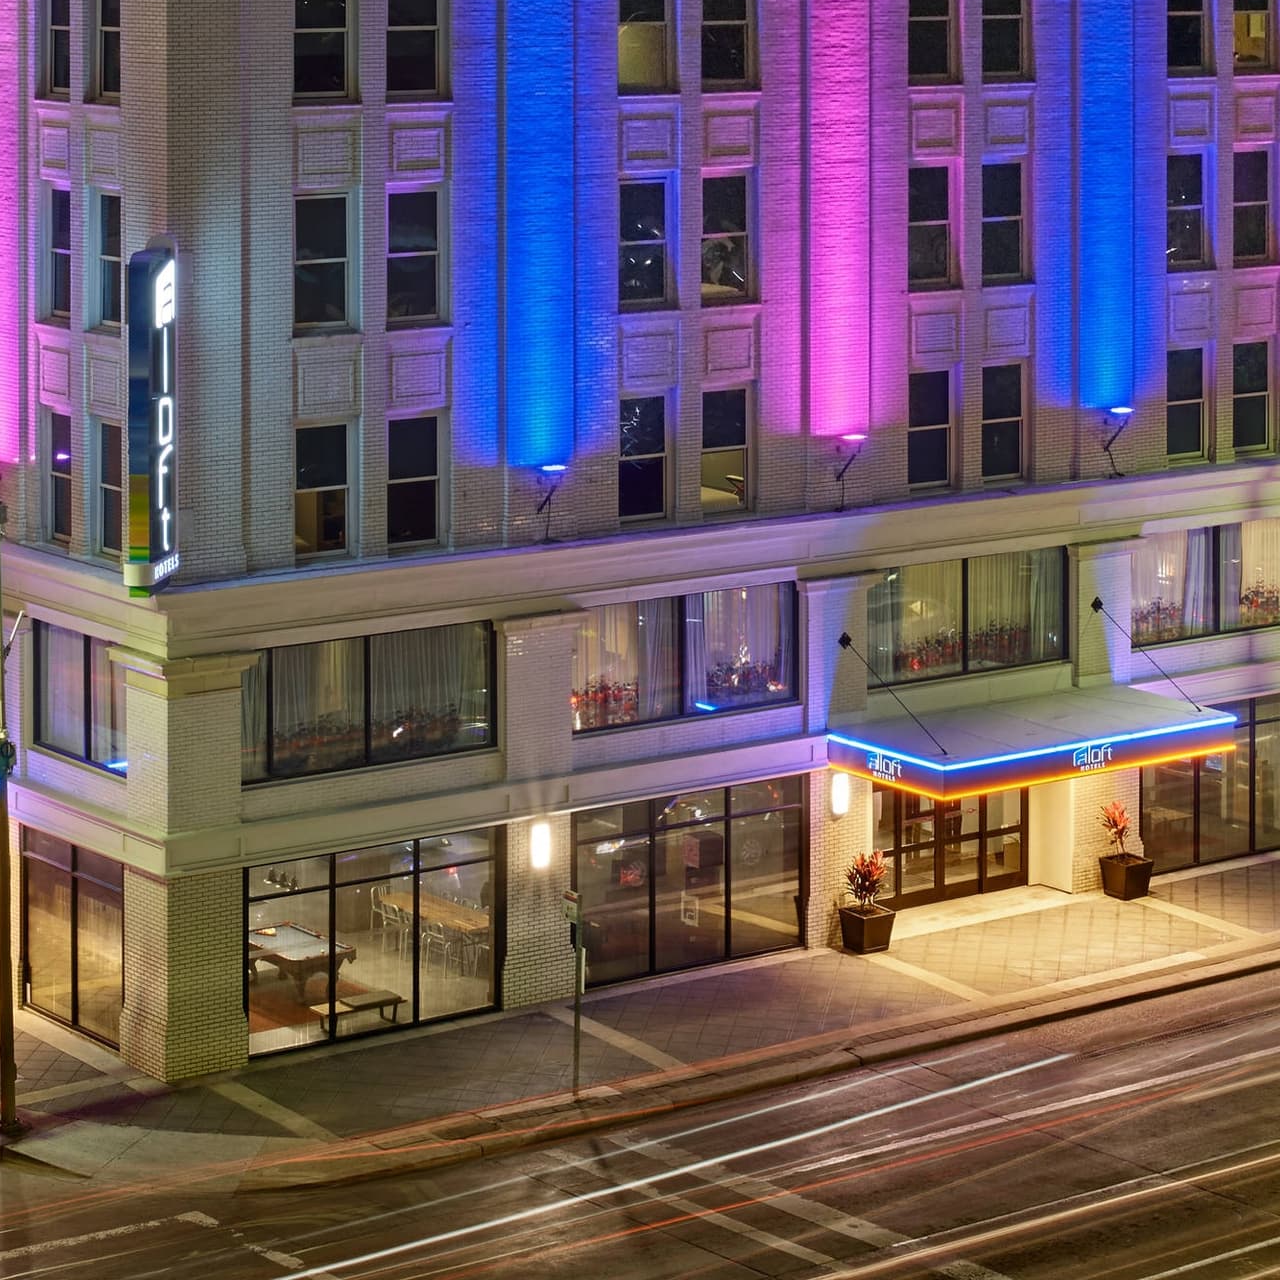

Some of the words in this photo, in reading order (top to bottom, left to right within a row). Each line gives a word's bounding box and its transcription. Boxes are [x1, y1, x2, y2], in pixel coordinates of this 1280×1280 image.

[155, 258, 176, 552] aloft
[154, 553, 180, 580] HOTELS
[867, 752, 902, 777] aloft
[1073, 744, 1113, 767] aloft
[1080, 762, 1106, 773] HOTELS
[872, 771, 896, 782] HOTELS
